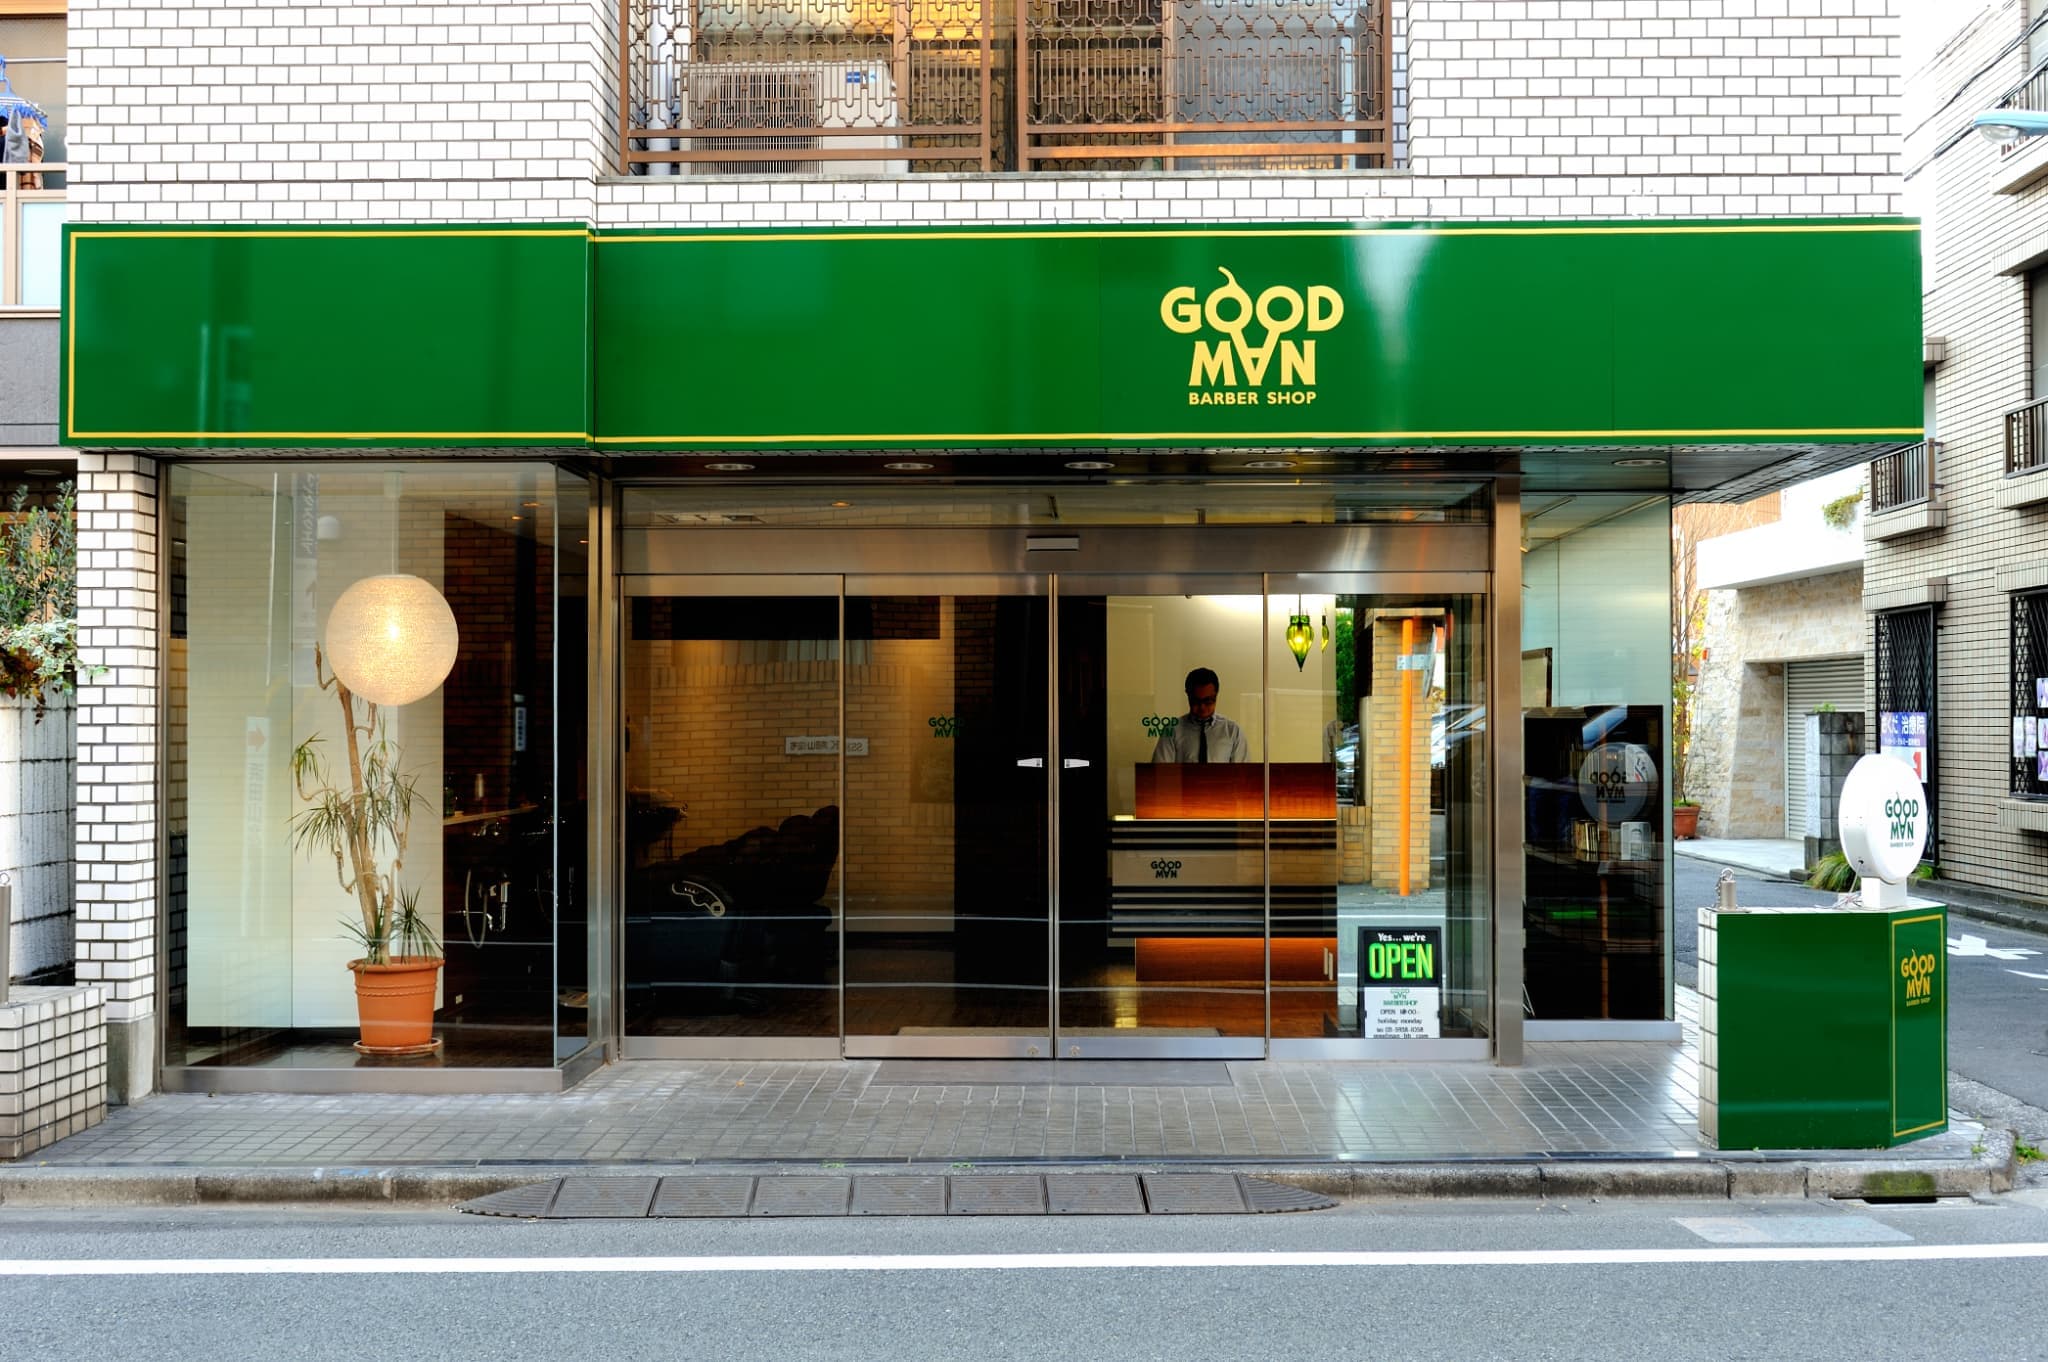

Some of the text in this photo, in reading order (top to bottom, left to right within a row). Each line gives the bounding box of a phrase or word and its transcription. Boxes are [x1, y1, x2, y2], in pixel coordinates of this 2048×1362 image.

[1160, 266, 1344, 334] GOOD
[1188, 339, 1316, 387] MAN
[1188, 391, 1317, 405] BARBER SHOP
[1142, 713, 1179, 727] GOOD
[1147, 727, 1174, 738] MAN
[1885, 792, 1919, 818] GOOD
[1890, 821, 1914, 840] MAN
[1151, 858, 1182, 870] GOOD
[1155, 870, 1178, 879] MAN
[1403, 932, 1427, 942] we're
[1368, 942, 1434, 979] OPEN
[1901, 949, 1936, 978] GOOD
[1906, 975, 1930, 999] MAN
